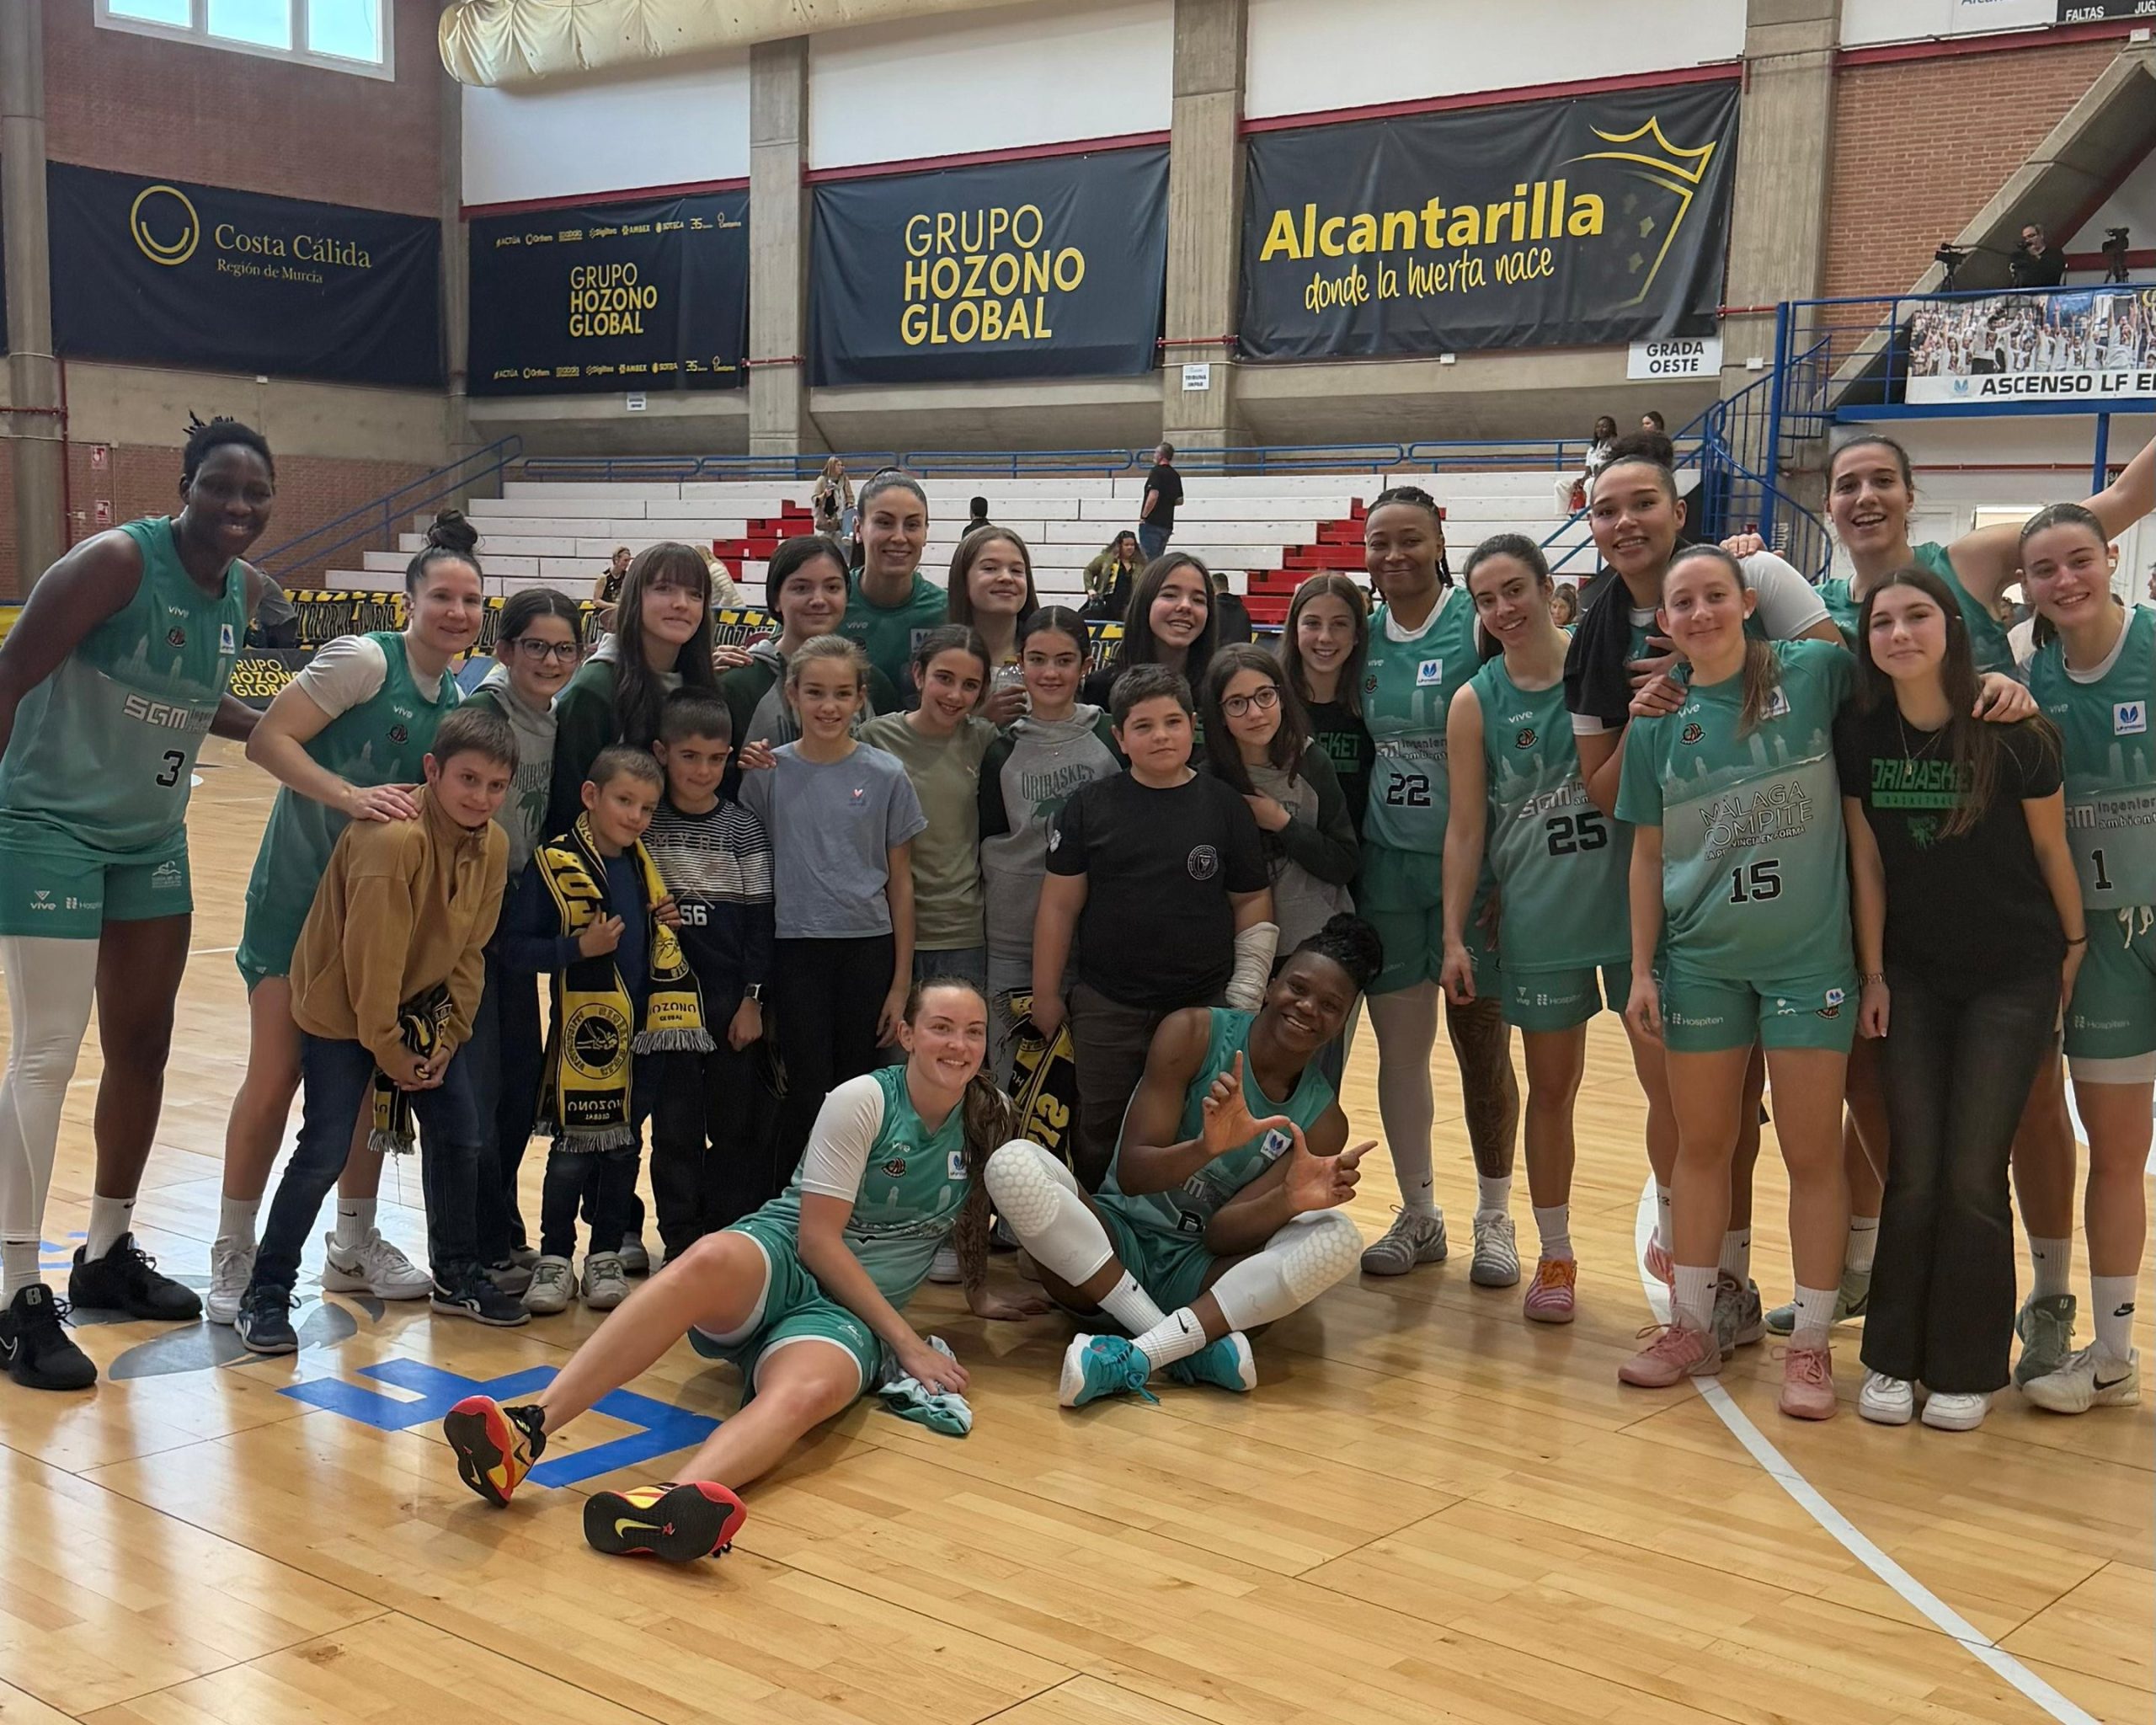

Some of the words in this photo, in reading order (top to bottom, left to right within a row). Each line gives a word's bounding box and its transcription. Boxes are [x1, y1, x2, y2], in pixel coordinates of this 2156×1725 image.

[2066, 6, 2105, 21] FALTAS
[905, 204, 1043, 257] GRUPO
[1260, 179, 1604, 261] Alcantarilla
[215, 224, 286, 257] Costa
[293, 233, 372, 269] Cálida
[217, 258, 260, 278] Región
[264, 264, 280, 279] de
[282, 267, 323, 284] Murcia
[570, 262, 638, 290] GRUPO
[905, 247, 1085, 301] HOZONO
[1305, 266, 1370, 313] donde
[1378, 260, 1398, 298] la
[1408, 250, 1483, 298] huerta
[1495, 246, 1555, 283] nace
[570, 286, 658, 313] HOZONO
[569, 312, 643, 337] GLOBAL
[901, 296, 1052, 345] GLOBAL
[1646, 341, 1705, 358] GRADA
[1649, 358, 1699, 374] OESTE
[1981, 375, 2092, 395] ASCENSO
[2100, 374, 2128, 392] LF
[236, 659, 282, 671] RUPO
[232, 683, 286, 697] GLOB
[1508, 710, 1534, 723] vive
[156, 750, 184, 788] 3
[1386, 772, 1431, 807] 22
[1546, 811, 1608, 856] 25
[1729, 859, 1782, 904] 15
[2092, 849, 2112, 889] 1
[30, 902, 56, 911] vive
[680, 905, 707, 926] 56
